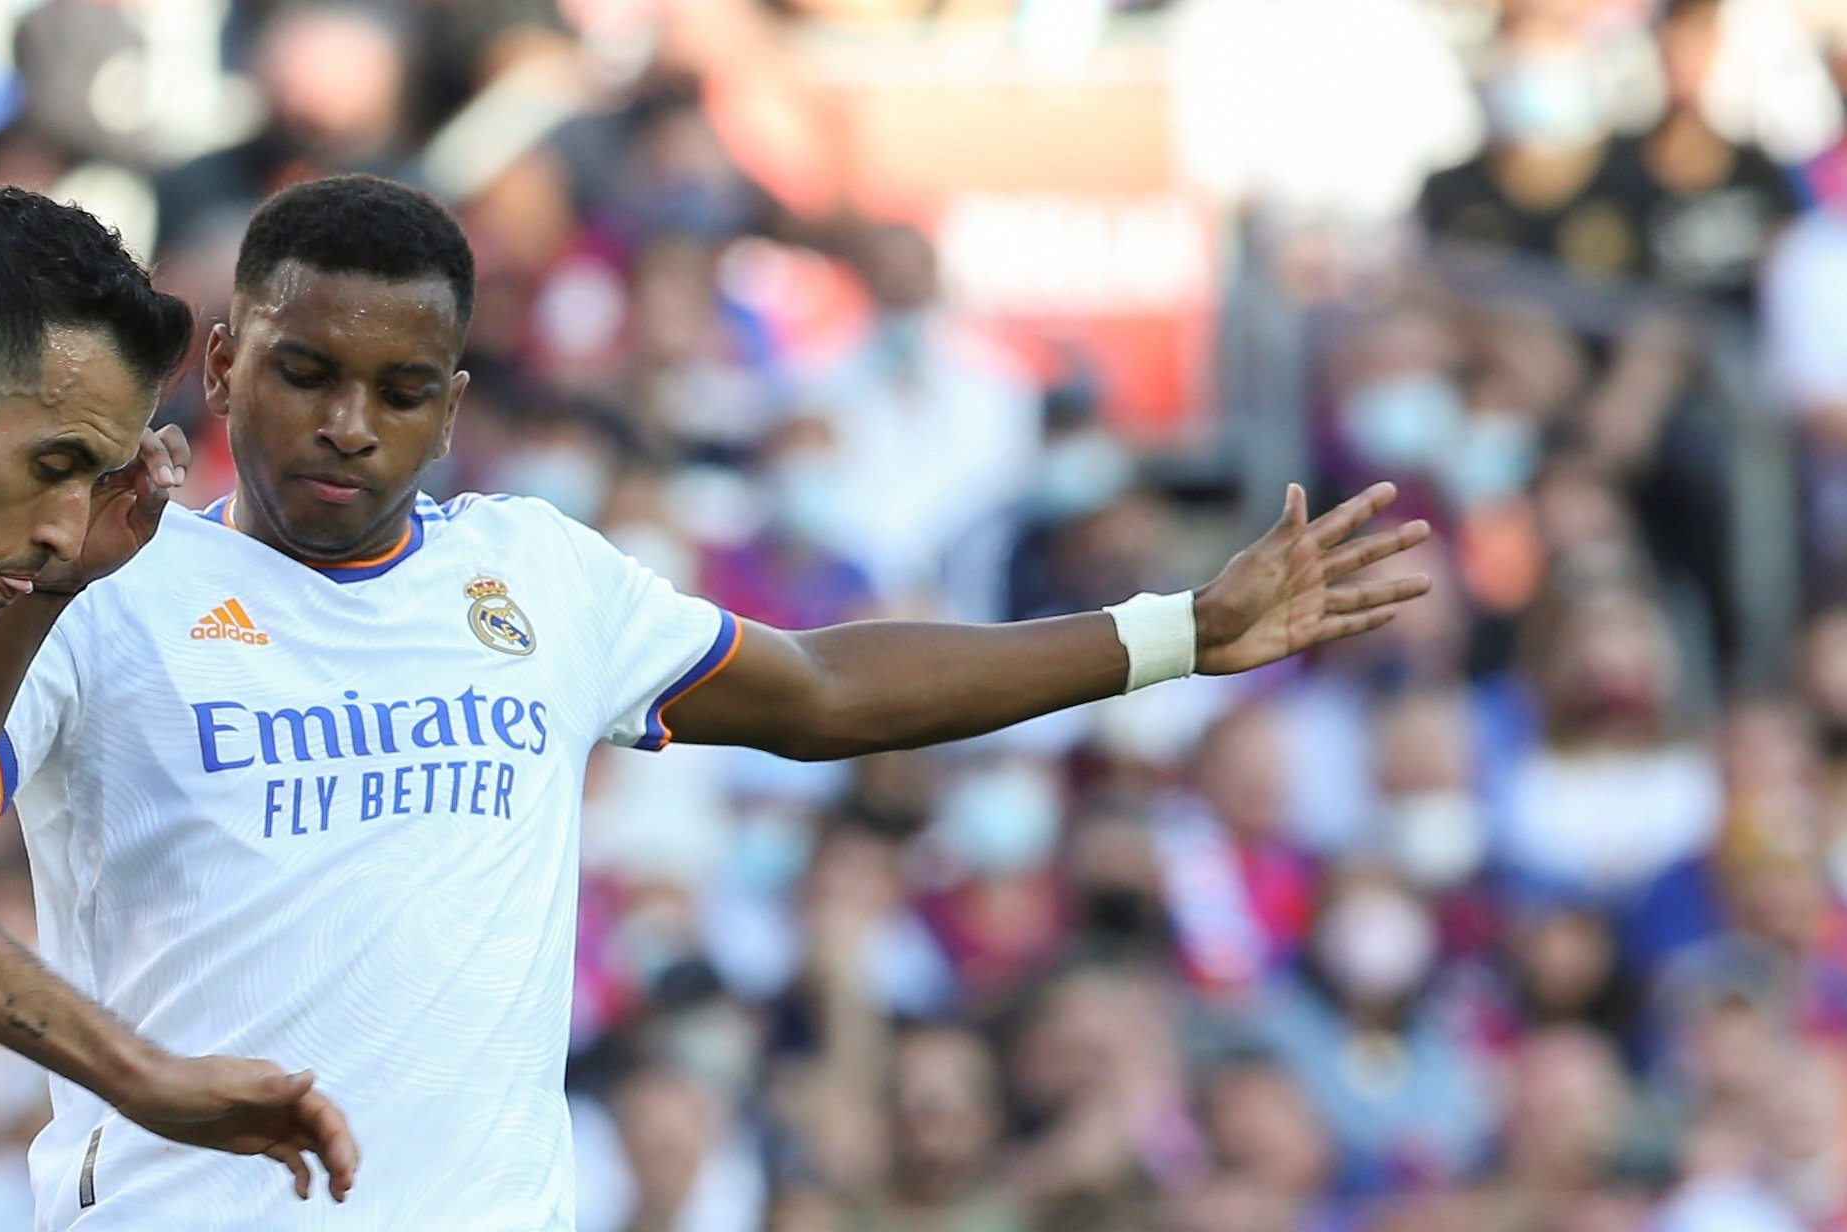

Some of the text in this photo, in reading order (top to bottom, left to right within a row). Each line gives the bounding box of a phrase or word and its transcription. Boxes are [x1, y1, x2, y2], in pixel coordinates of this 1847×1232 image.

[189, 622, 270, 646] adidas
[190, 685, 547, 774] Emirates
[263, 760, 515, 839] FLY BETTER
